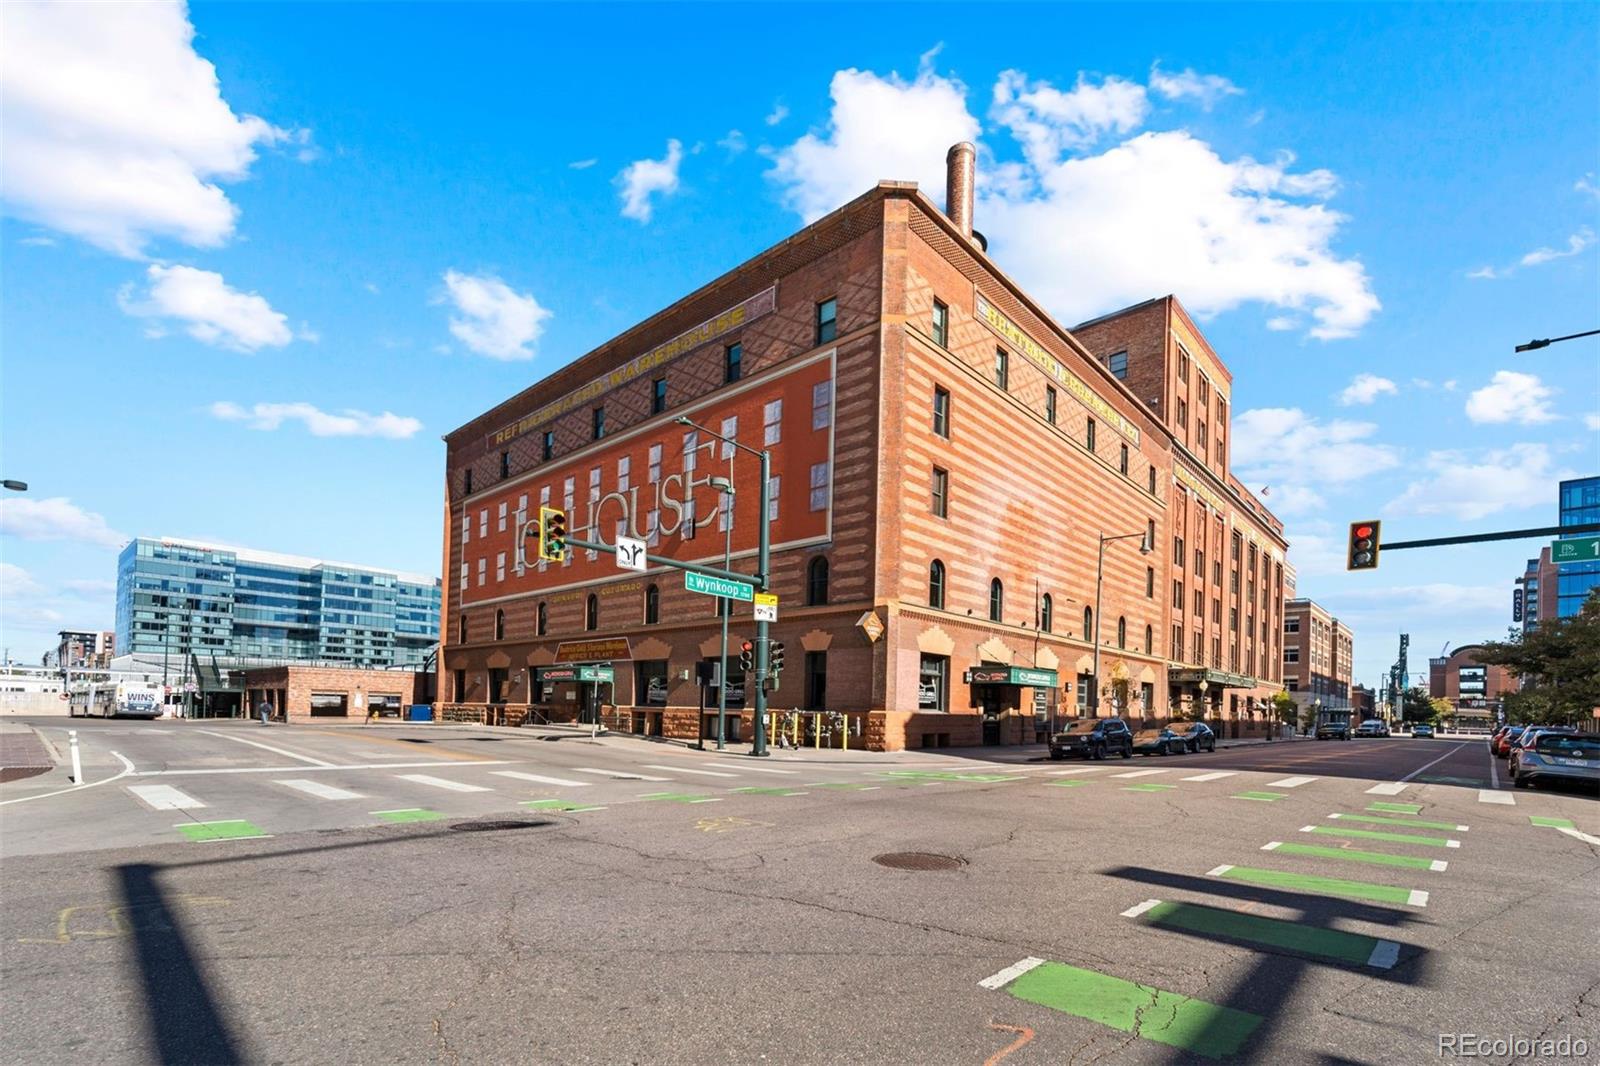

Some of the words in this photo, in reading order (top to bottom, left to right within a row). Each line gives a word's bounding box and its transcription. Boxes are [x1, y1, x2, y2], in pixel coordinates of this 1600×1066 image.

[608, 306, 745, 384] WAREHOUSE
[510, 440, 718, 573] ICHOUSE
[695, 576, 739, 598] Wynkoop
[127, 692, 155, 701] WINS
